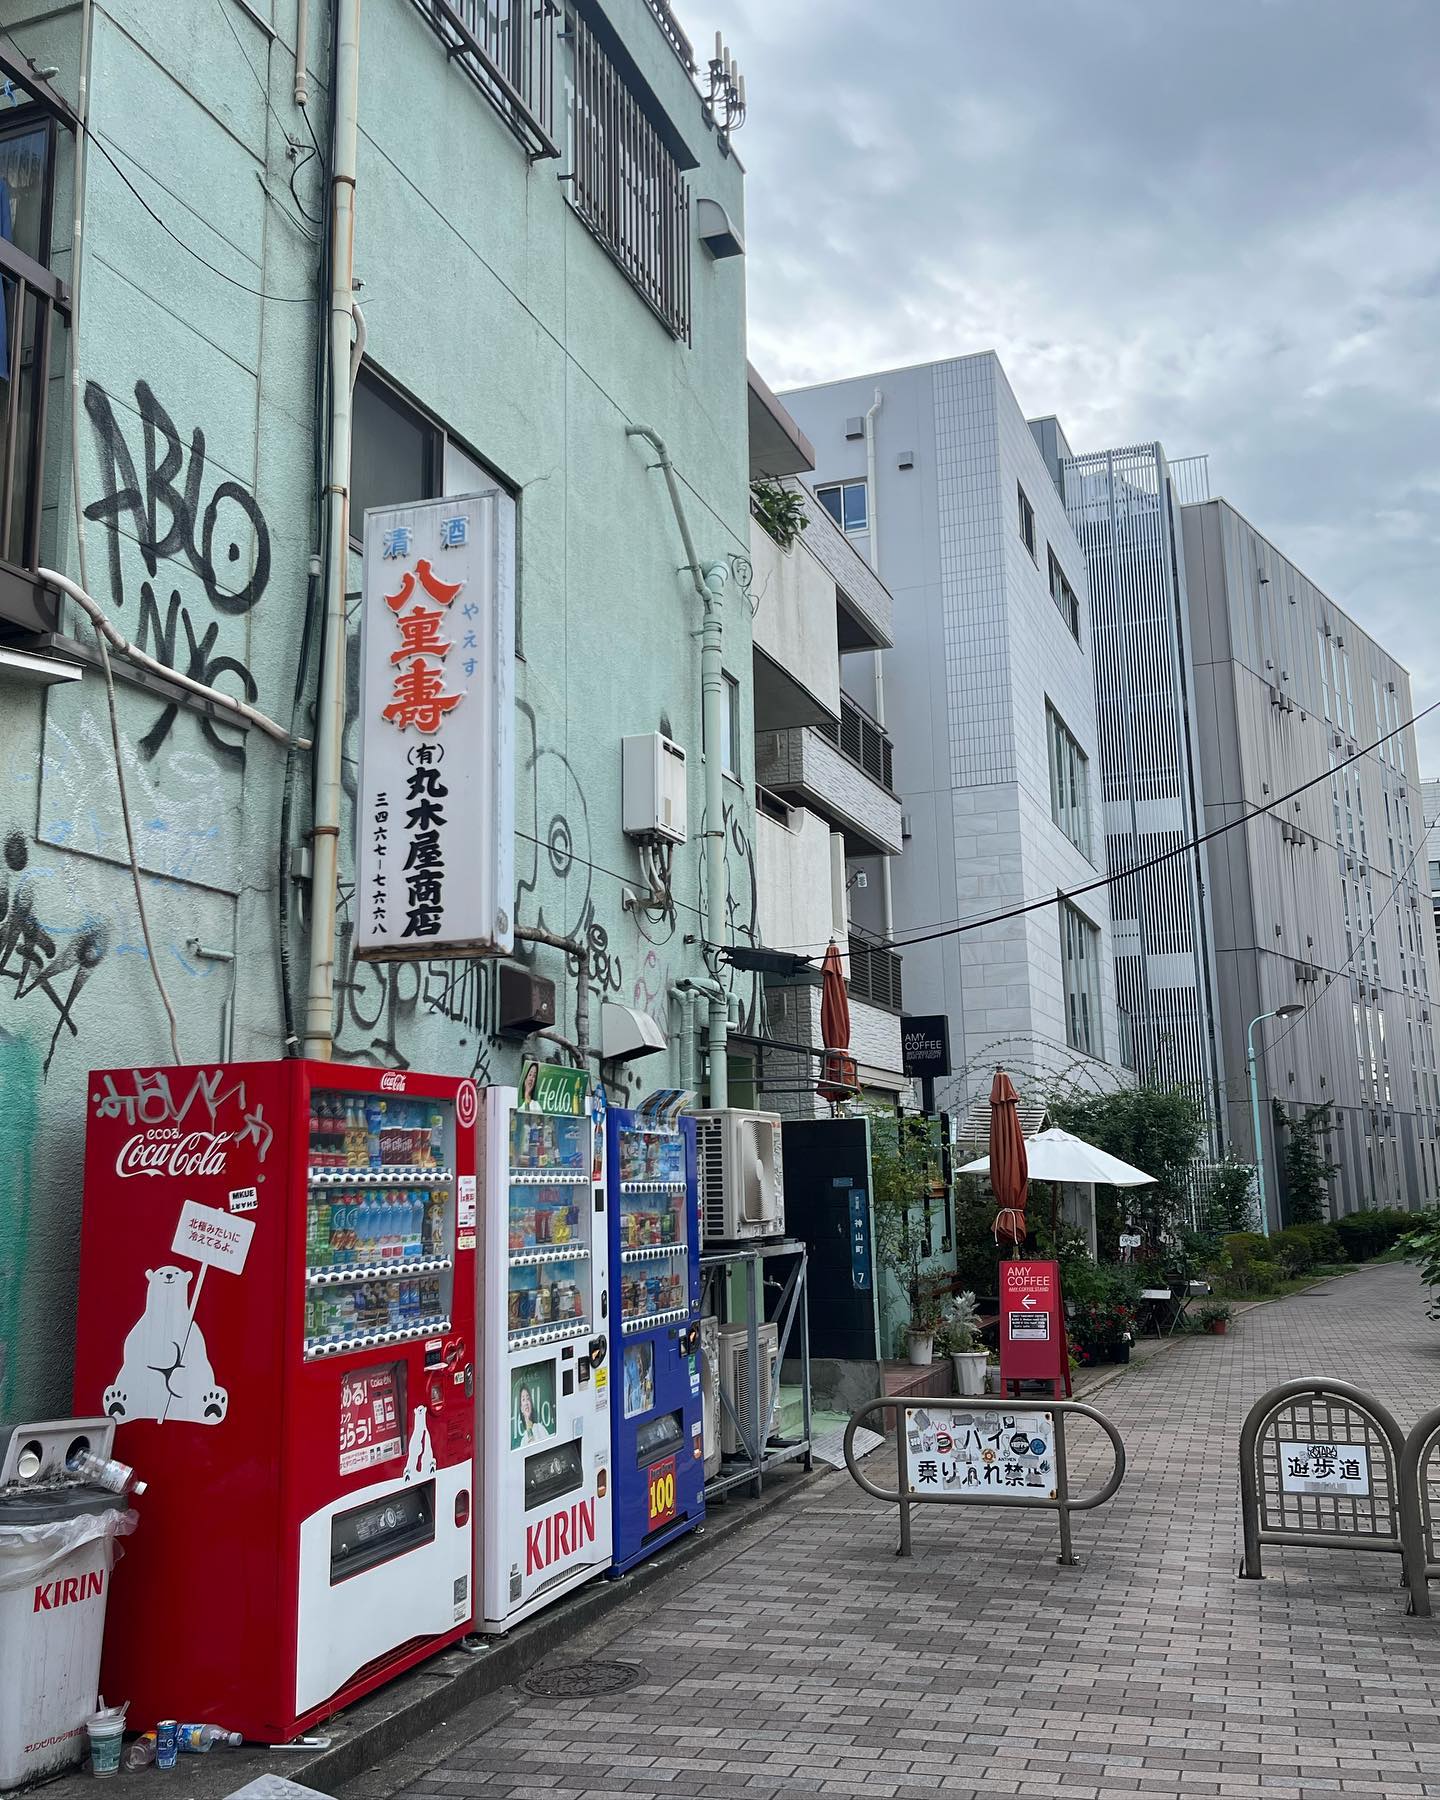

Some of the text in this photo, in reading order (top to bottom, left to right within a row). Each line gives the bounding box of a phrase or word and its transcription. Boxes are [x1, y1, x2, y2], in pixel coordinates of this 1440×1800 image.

[461, 602, 479, 678] やえす
[904, 1032, 926, 1042] AMY
[904, 1040, 943, 1051] COFFEE
[1007, 1267, 1032, 1276] AMY
[857, 1272, 865, 1284] 7
[1007, 1276, 1050, 1286] COFFEE
[1287, 1456, 1362, 1481] 遊歩道
[526, 1496, 597, 1577] KIRIN
[33, 1569, 105, 1613] KIRIN
